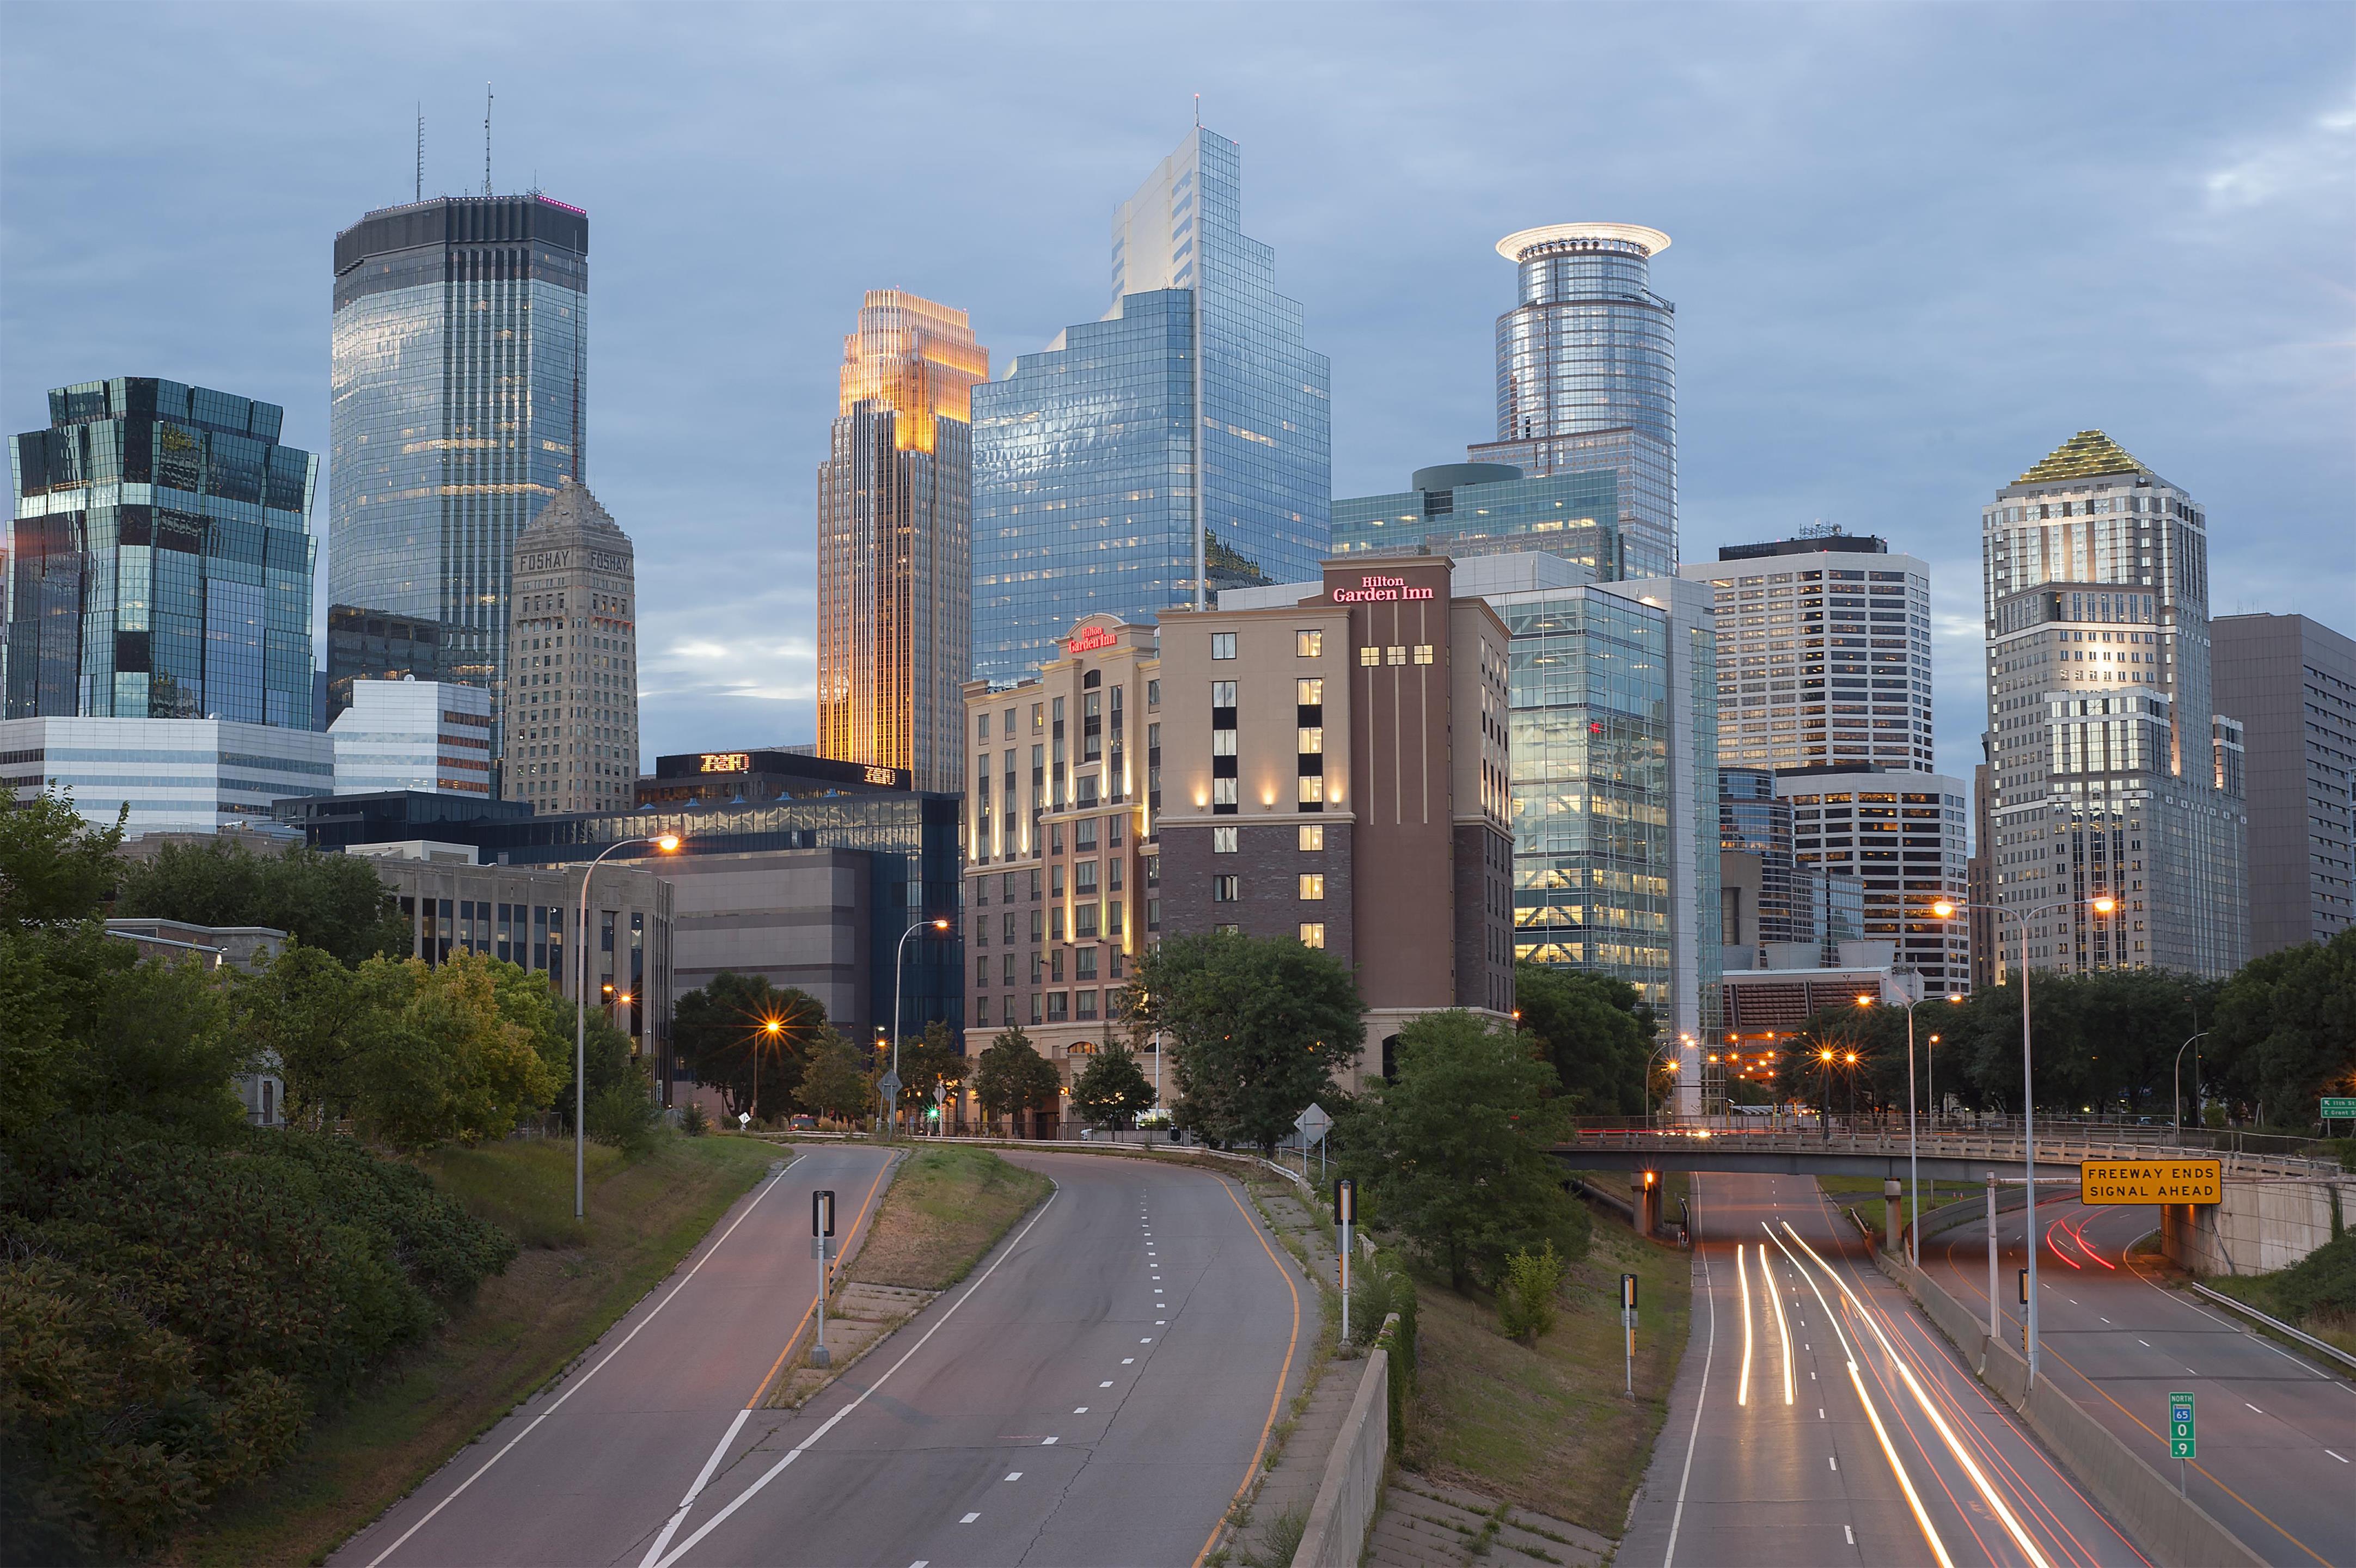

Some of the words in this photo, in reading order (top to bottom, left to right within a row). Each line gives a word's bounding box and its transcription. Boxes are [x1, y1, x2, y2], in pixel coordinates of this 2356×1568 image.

[520, 550, 570, 572] FOSHAY
[591, 551, 628, 573] FOSHAY
[1362, 576, 1405, 587] Hilton
[1333, 587, 1398, 602] Garden
[1401, 586, 1434, 600] Inn
[1082, 627, 1103, 638] Hilton
[1069, 637, 1100, 653] Garden
[1100, 634, 1117, 646] Inn
[2088, 1168, 2163, 1179] FREEWAY
[2172, 1168, 2214, 1179] ENDS
[2090, 1186, 2149, 1197] SIGNAL
[2157, 1186, 2213, 1197] AHEAD
[2176, 1411, 2188, 1419] 65
[2178, 1424, 2187, 1437] 0
